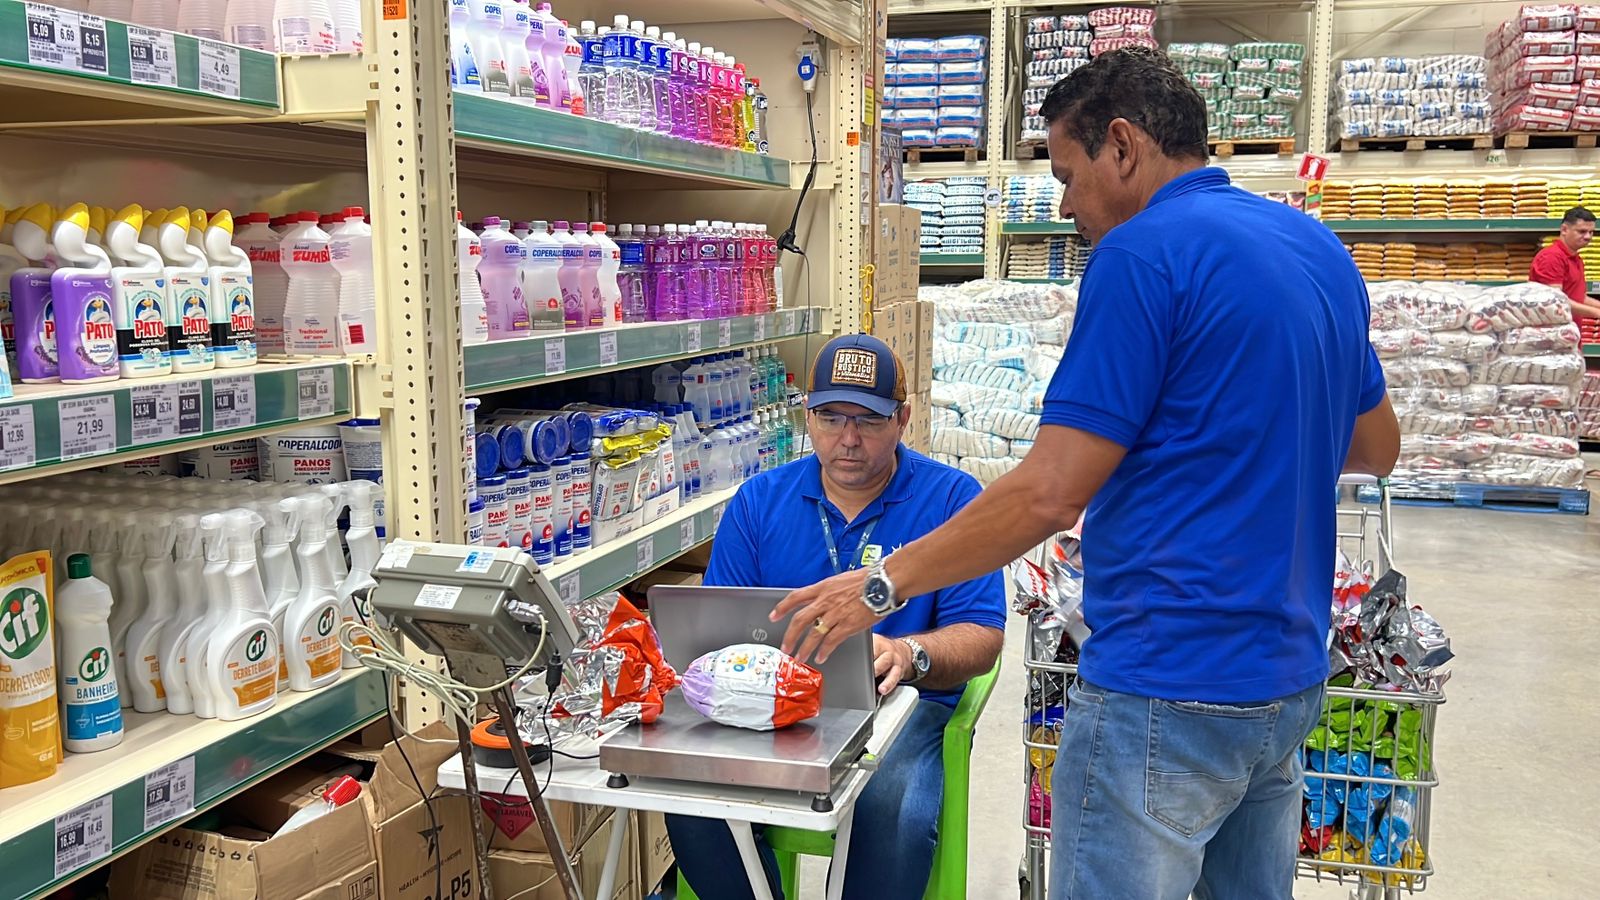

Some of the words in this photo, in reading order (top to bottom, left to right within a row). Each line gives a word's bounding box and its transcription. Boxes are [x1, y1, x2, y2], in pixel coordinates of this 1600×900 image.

[33, 23, 49, 38] 6,09
[60, 28, 75, 41] 6,69
[85, 33, 100, 46] 6,15
[214, 61, 229, 75] 4,49
[86, 322, 113, 340] PATO
[135, 320, 165, 337] PATO
[183, 317, 208, 335] PATO
[231, 314, 254, 332] PATO
[839, 353, 872, 366] BRUTO
[7, 428, 24, 443] 12,99
[77, 419, 103, 436] 21,99
[294, 458, 332, 467] PANOS
[0, 566, 35, 583] CONÔMICO
[0, 593, 40, 652] Cif
[318, 608, 335, 635] Cif
[248, 632, 266, 659] Cif
[82, 650, 107, 679] Cif
[233, 662, 258, 680] DERRETE
[506, 820, 515, 833] 3
